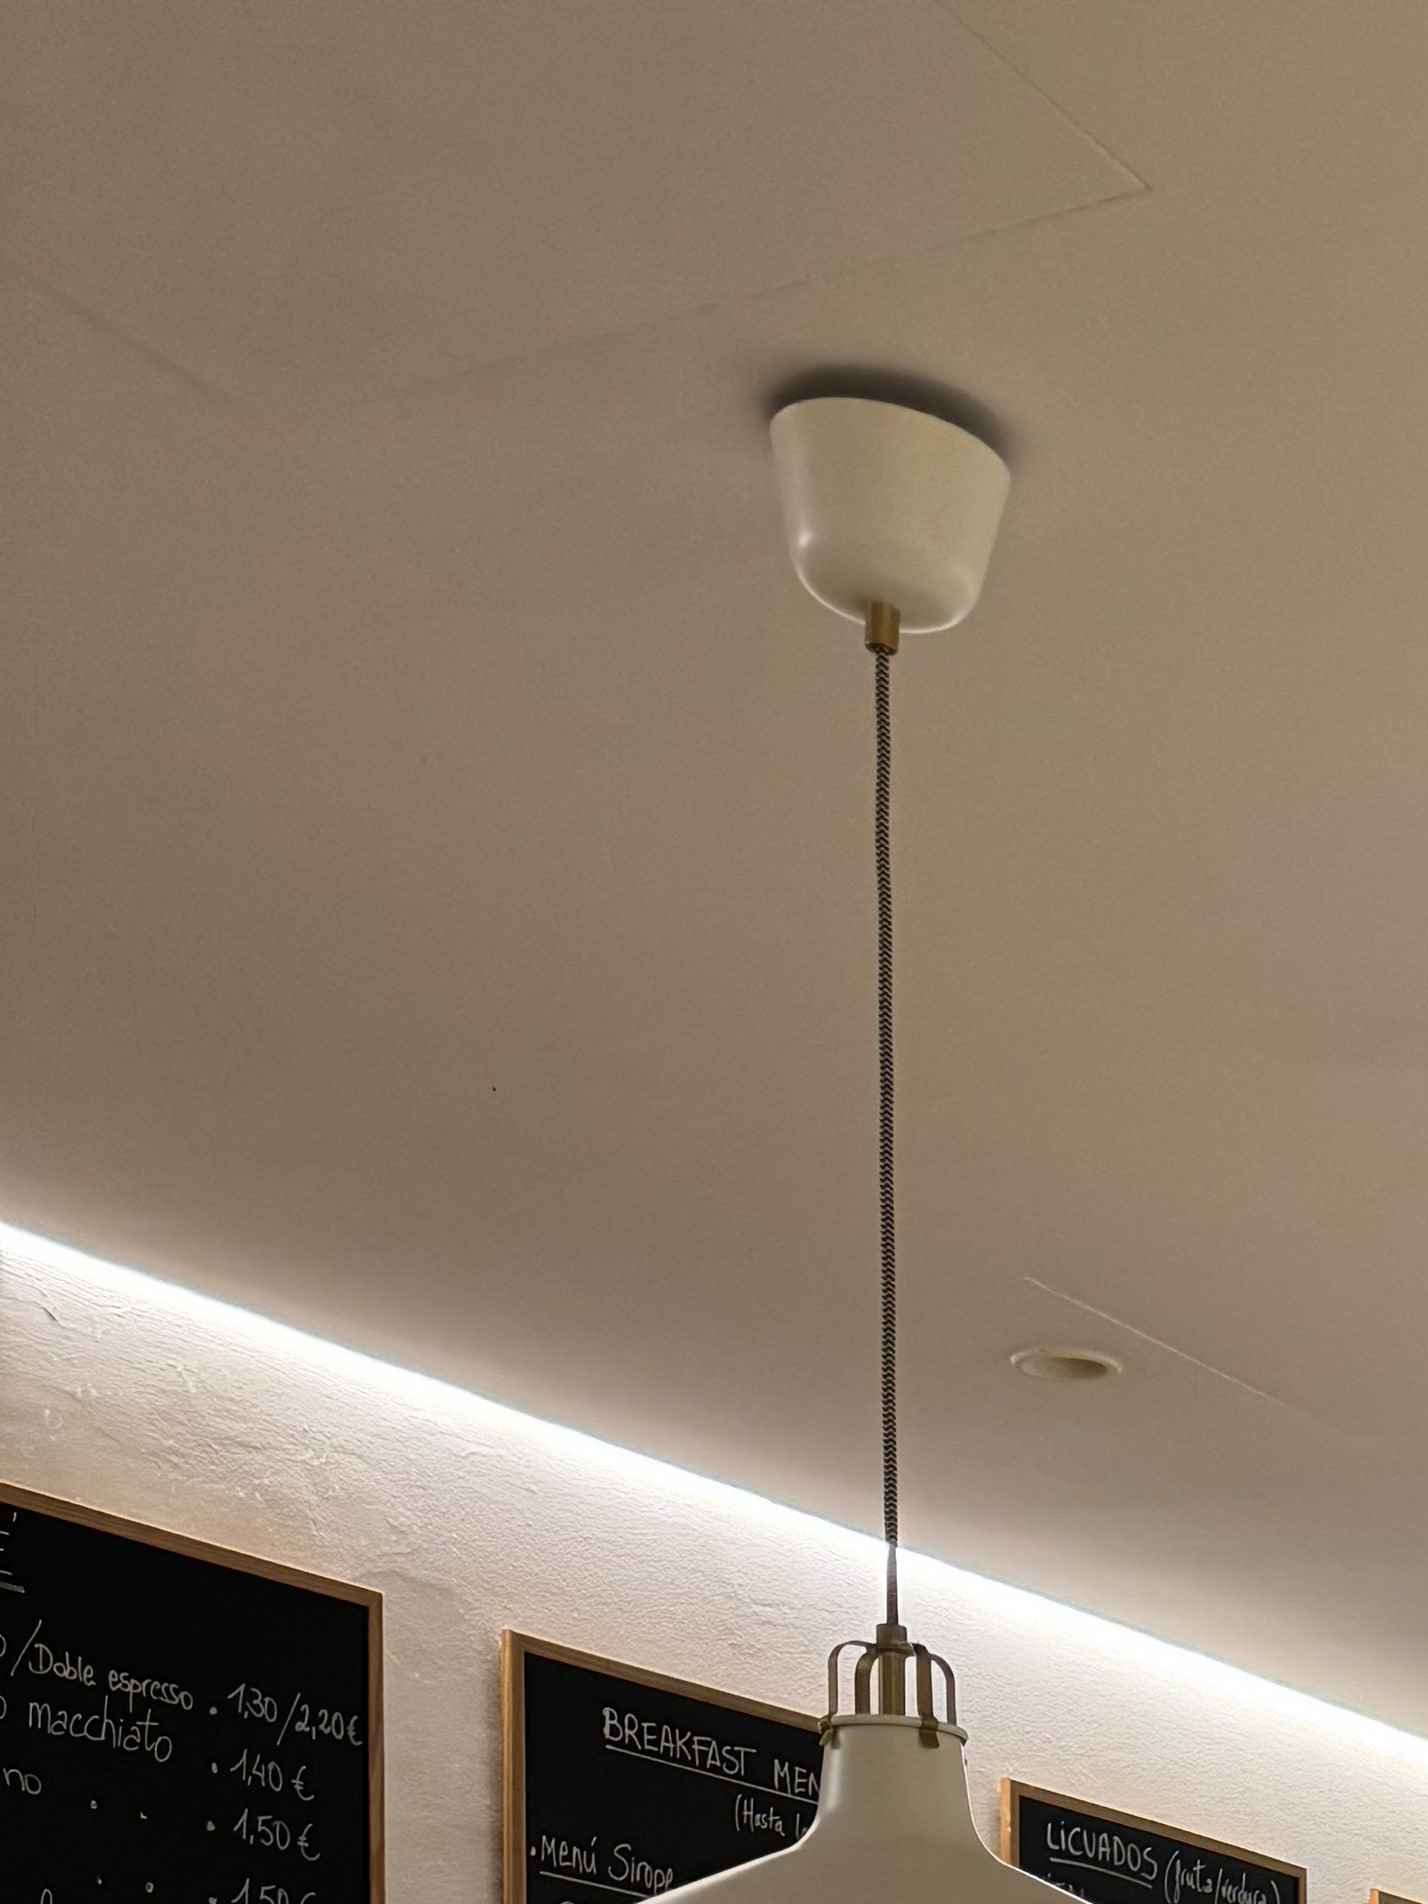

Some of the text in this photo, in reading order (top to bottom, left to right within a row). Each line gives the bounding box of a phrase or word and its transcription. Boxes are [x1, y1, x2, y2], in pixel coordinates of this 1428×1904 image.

[108, 1668, 193, 1712] espresso
[29, 1696, 173, 1762] macchiato
[602, 1706, 820, 1797] BREAKFAST MEN
[541, 1834, 598, 1876] Menú
